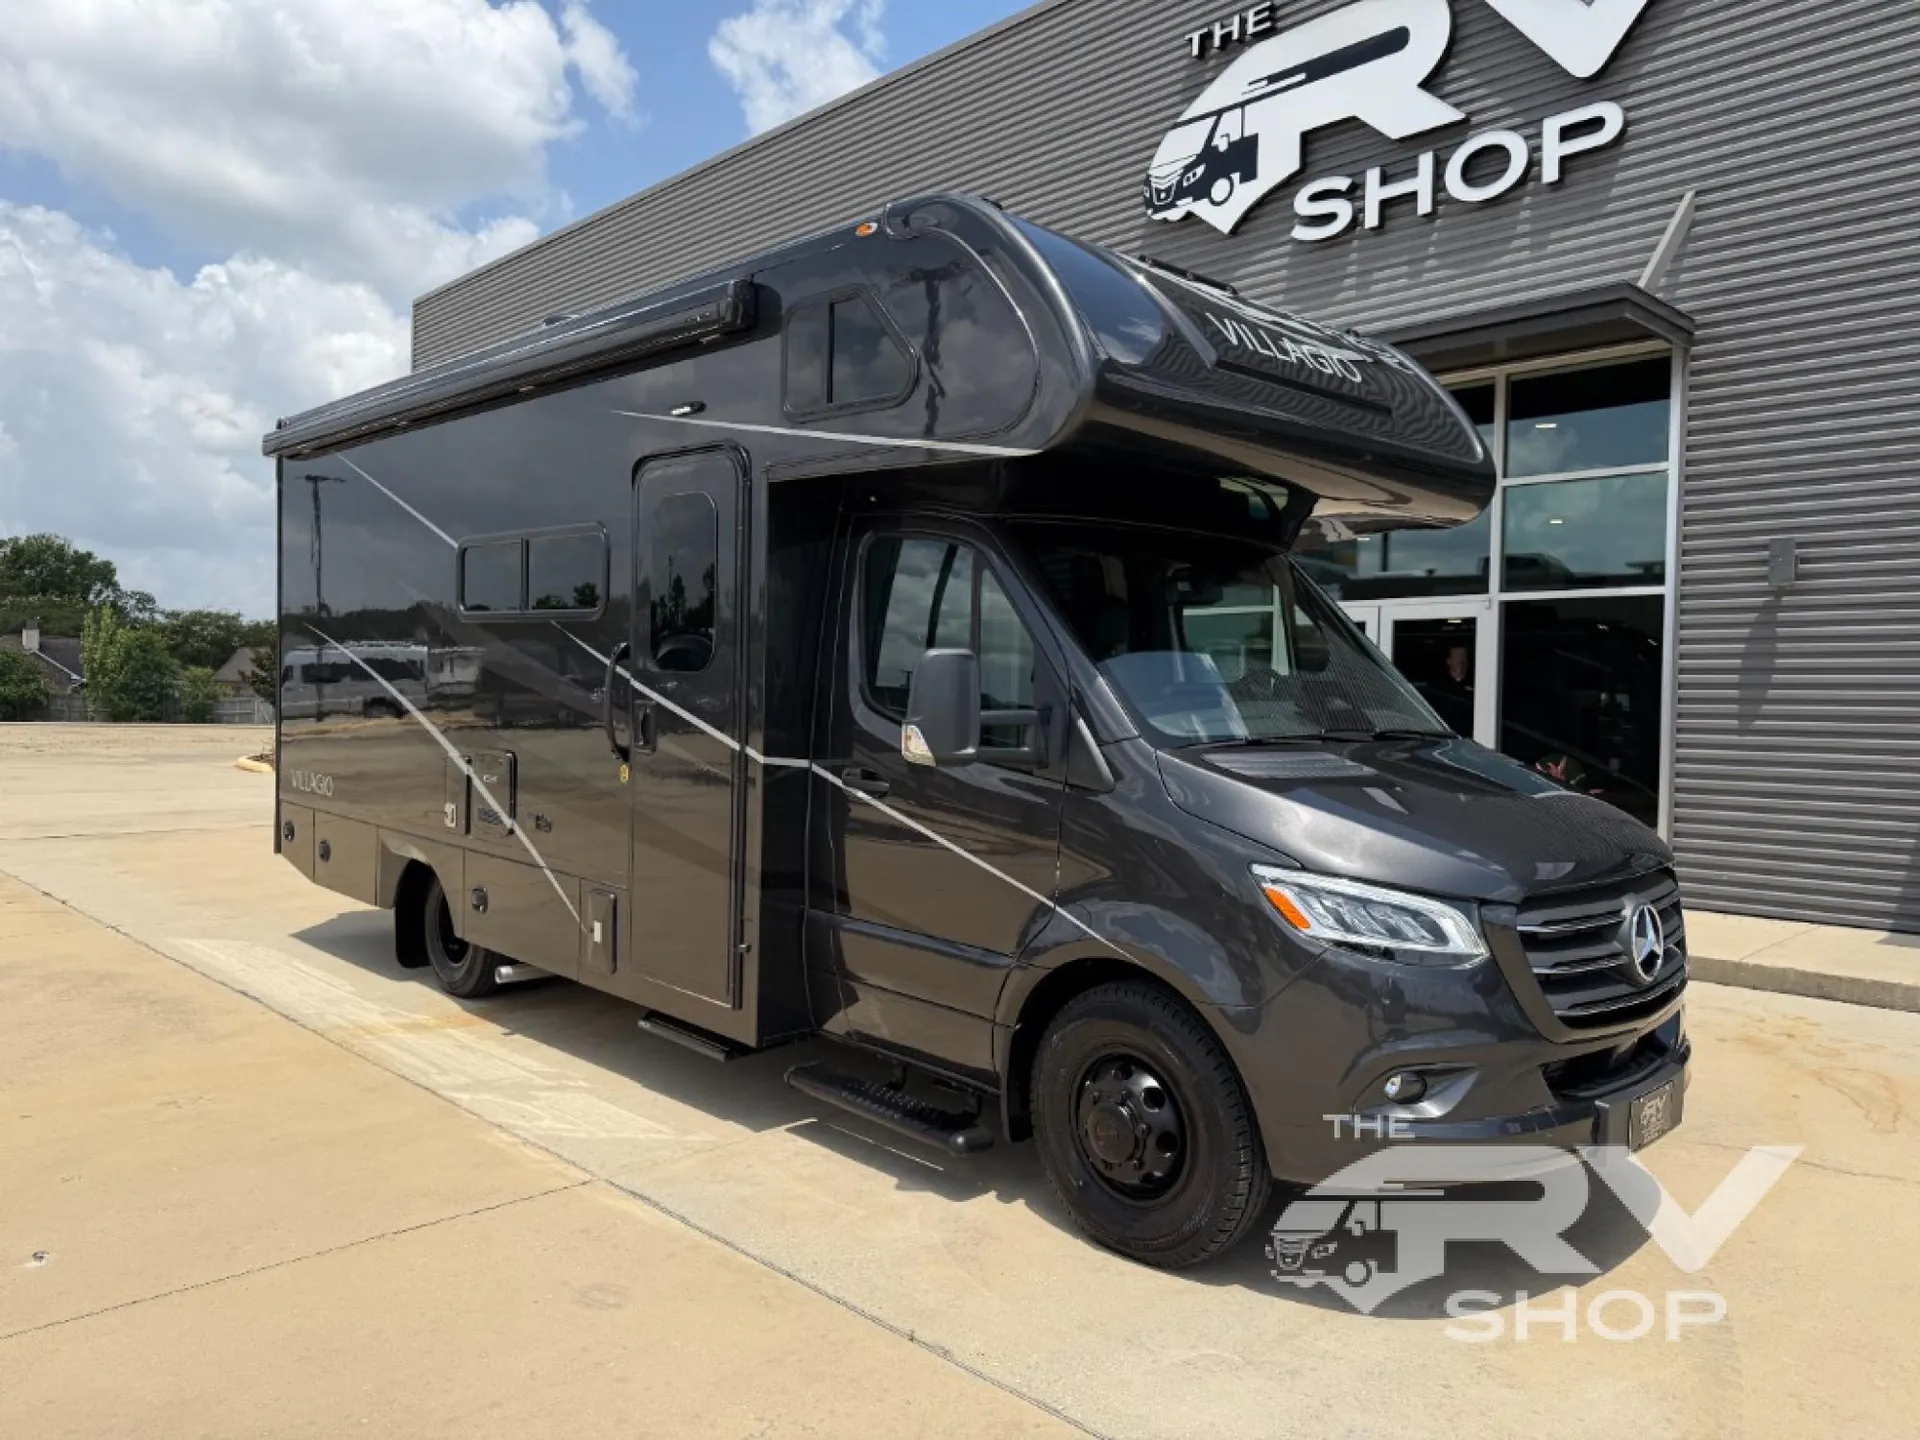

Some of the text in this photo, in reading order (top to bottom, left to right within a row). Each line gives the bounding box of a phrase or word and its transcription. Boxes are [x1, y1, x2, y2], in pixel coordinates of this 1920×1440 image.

[1184, 1, 1272, 57] THE
[1291, 100, 1626, 241] SHOP
[1206, 312, 1363, 384] VILLAGIO
